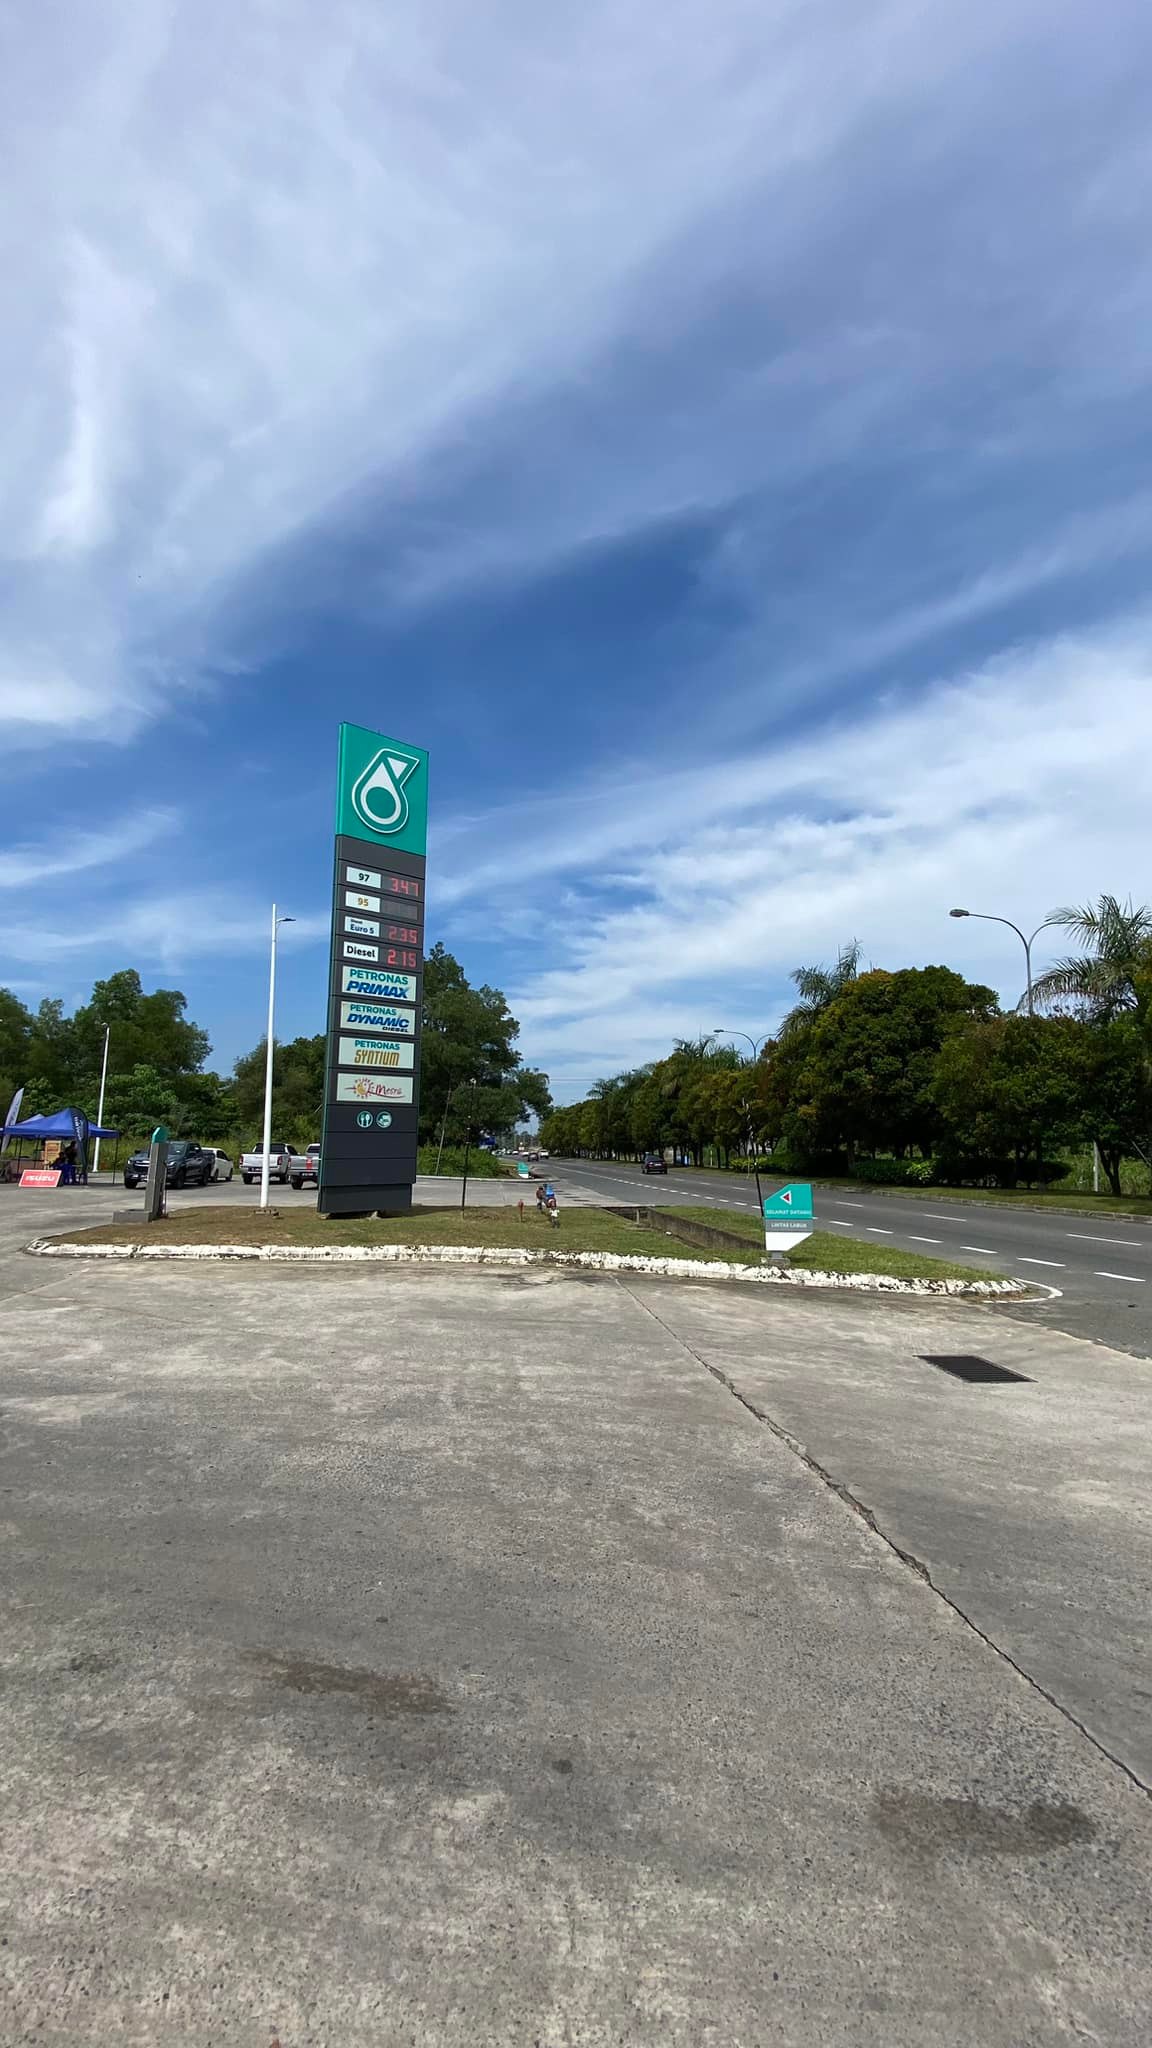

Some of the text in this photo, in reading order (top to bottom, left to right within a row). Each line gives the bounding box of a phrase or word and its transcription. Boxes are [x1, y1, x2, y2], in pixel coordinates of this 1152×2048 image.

[358, 873, 370, 882] 97
[357, 897, 369, 906] 95
[350, 924, 368, 933] Euro
[347, 945, 375, 958] Diesel
[350, 969, 408, 985] PETRONAS
[347, 980, 410, 998] PRIMAX
[350, 1004, 397, 1015] PETRONAS
[347, 1013, 409, 1027] DYNAMIC
[355, 1040, 400, 1050] PETRONAS
[354, 1049, 400, 1066] SYNTIUM
